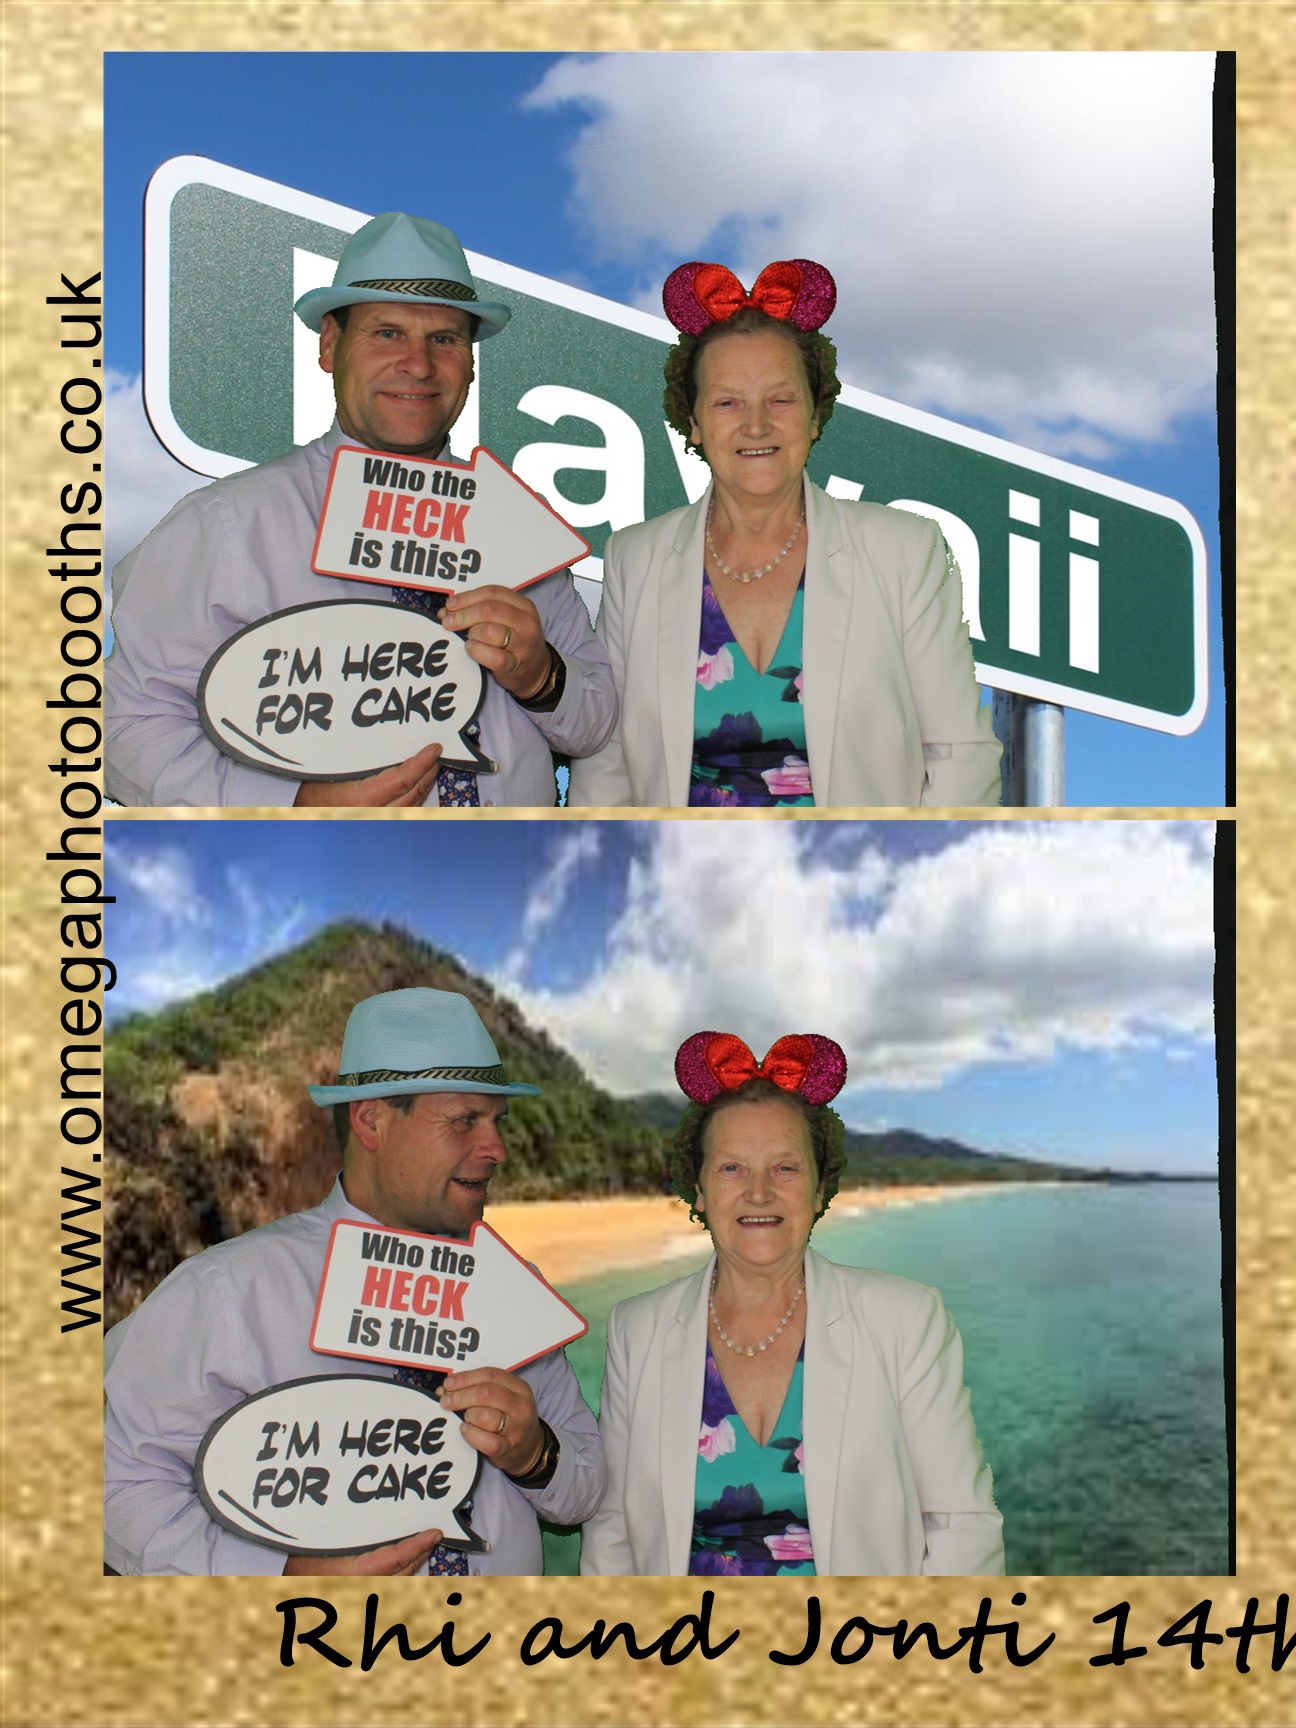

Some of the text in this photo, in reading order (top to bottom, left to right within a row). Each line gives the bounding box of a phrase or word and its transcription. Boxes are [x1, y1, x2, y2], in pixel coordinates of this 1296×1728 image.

[363, 457, 476, 500] Who the
[363, 490, 470, 543] HECK
[349, 532, 481, 582] is this?
[258, 640, 449, 688] I'M HERE
[256, 683, 457, 736] FOR CAKE
[362, 1230, 475, 1277] Who the
[362, 1266, 468, 1320] HECK
[348, 1309, 479, 1361] is this?
[256, 1418, 447, 1461] I'M HERE
[253, 1461, 453, 1509] FOR CAKE
